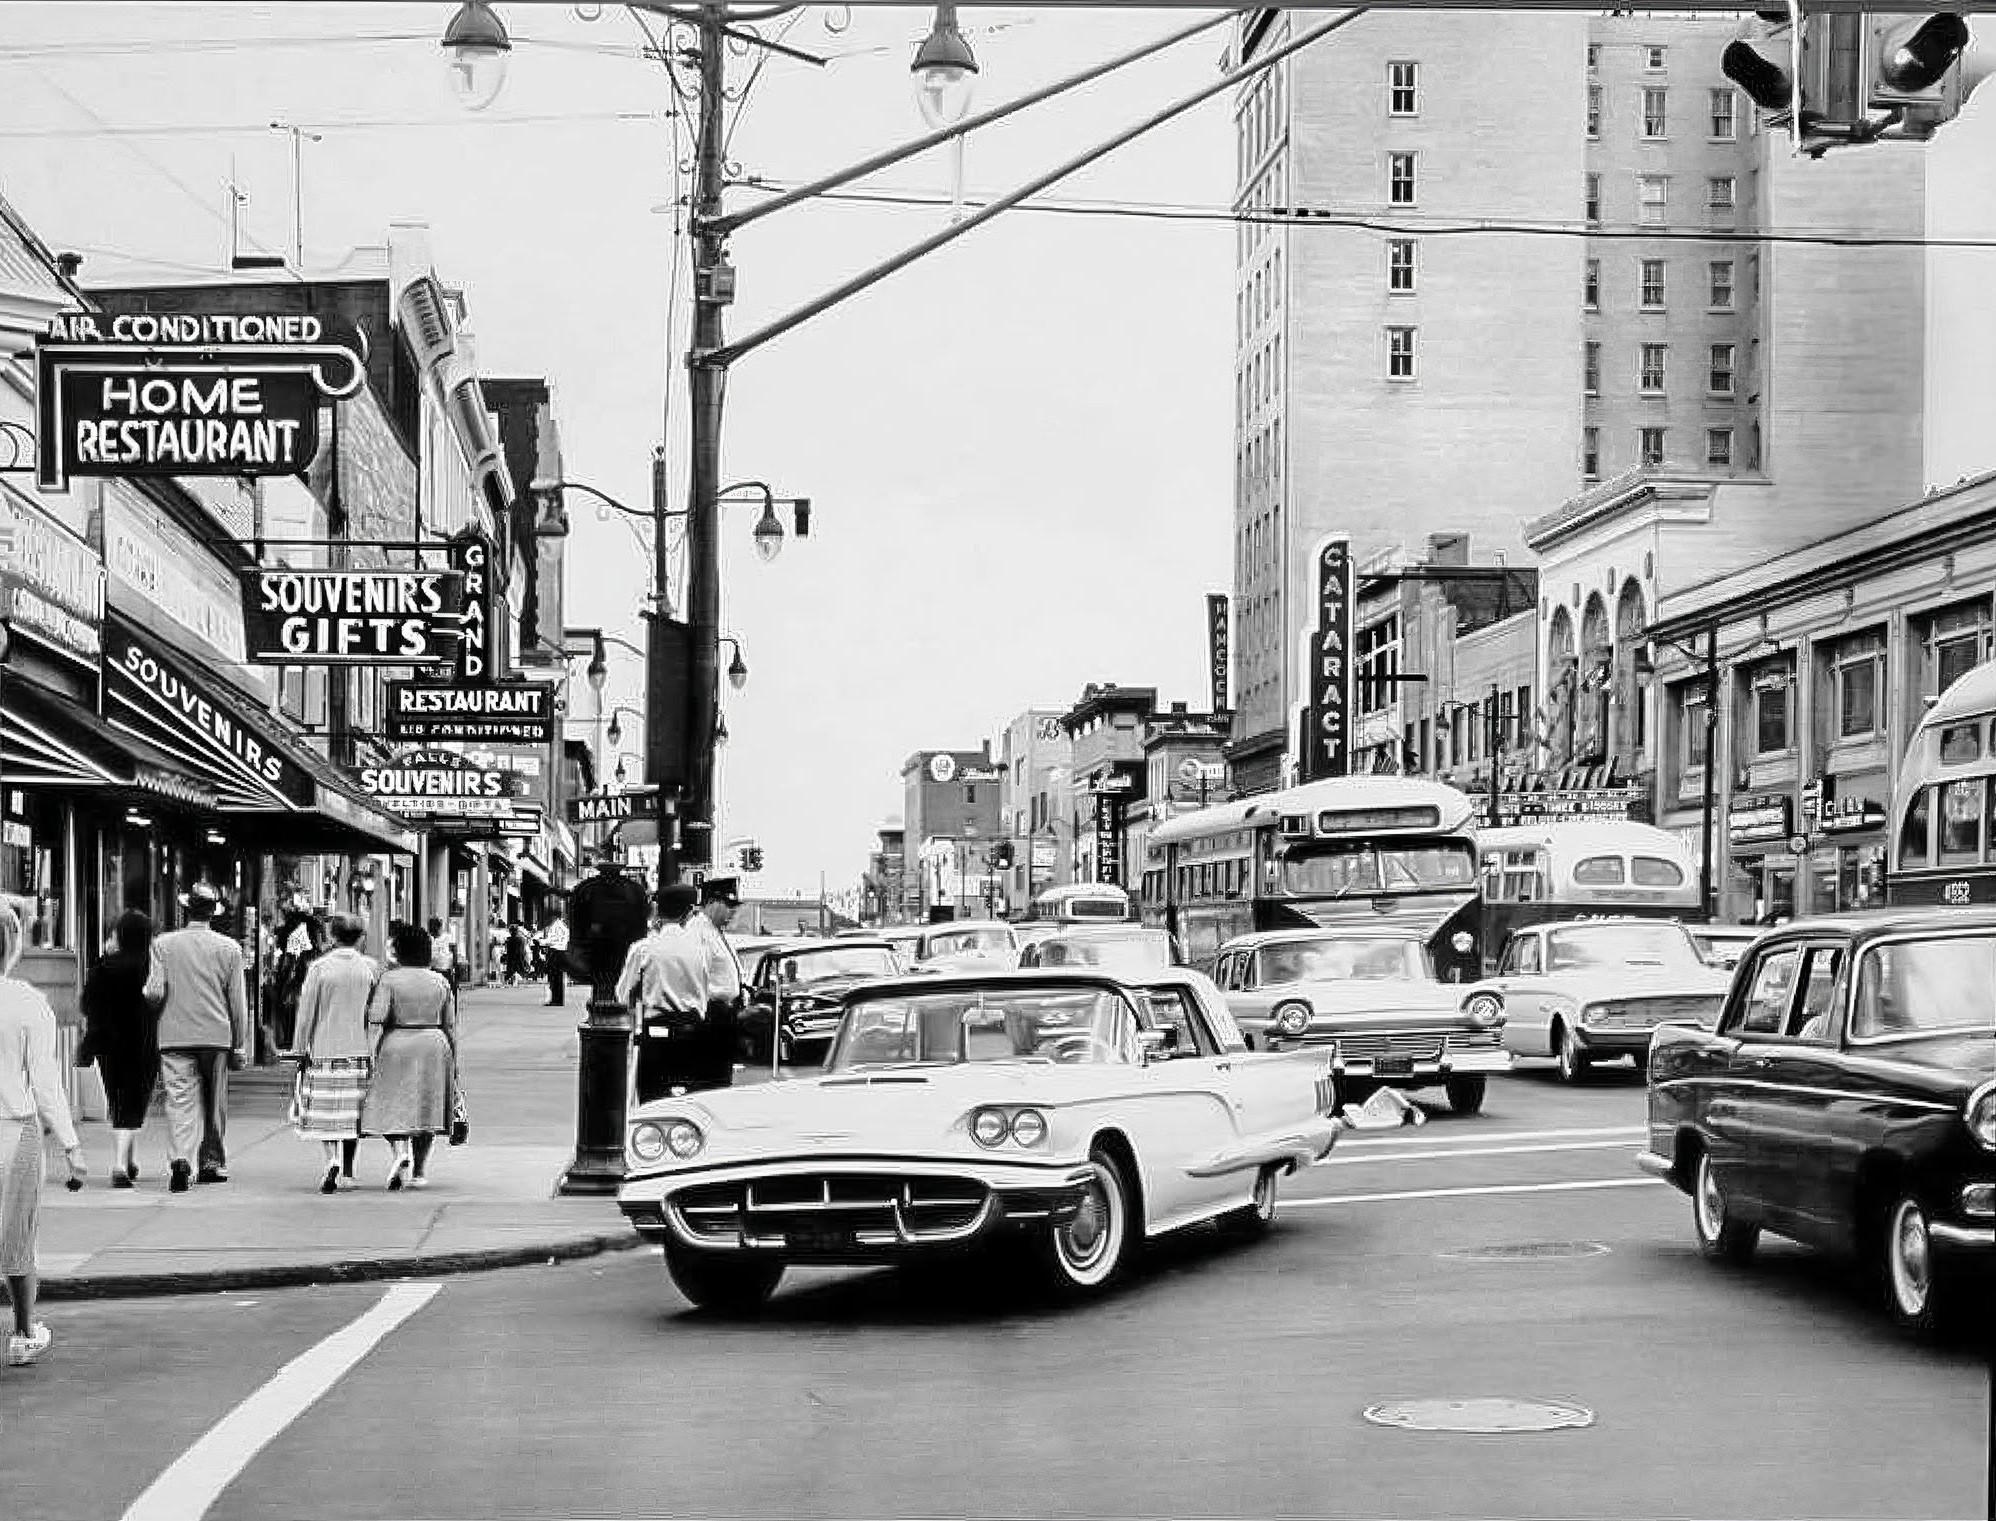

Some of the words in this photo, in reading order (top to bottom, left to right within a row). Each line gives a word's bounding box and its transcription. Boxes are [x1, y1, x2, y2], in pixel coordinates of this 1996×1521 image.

[51, 315, 101, 341] AIR
[113, 315, 321, 342] CONDITIONED
[103, 377, 264, 414] HOME
[77, 419, 300, 464] RESTAURANT
[260, 576, 443, 614] SOUVENIRS
[464, 545, 485, 677] GRAND
[282, 617, 427, 656] GIFTS
[1321, 547, 1343, 759] CATARACT
[124, 645, 284, 782] SOUVENIRS
[400, 689, 542, 714] RESTAURANT
[361, 768, 503, 797] SOUVENIRS
[578, 797, 632, 819] MAIN
